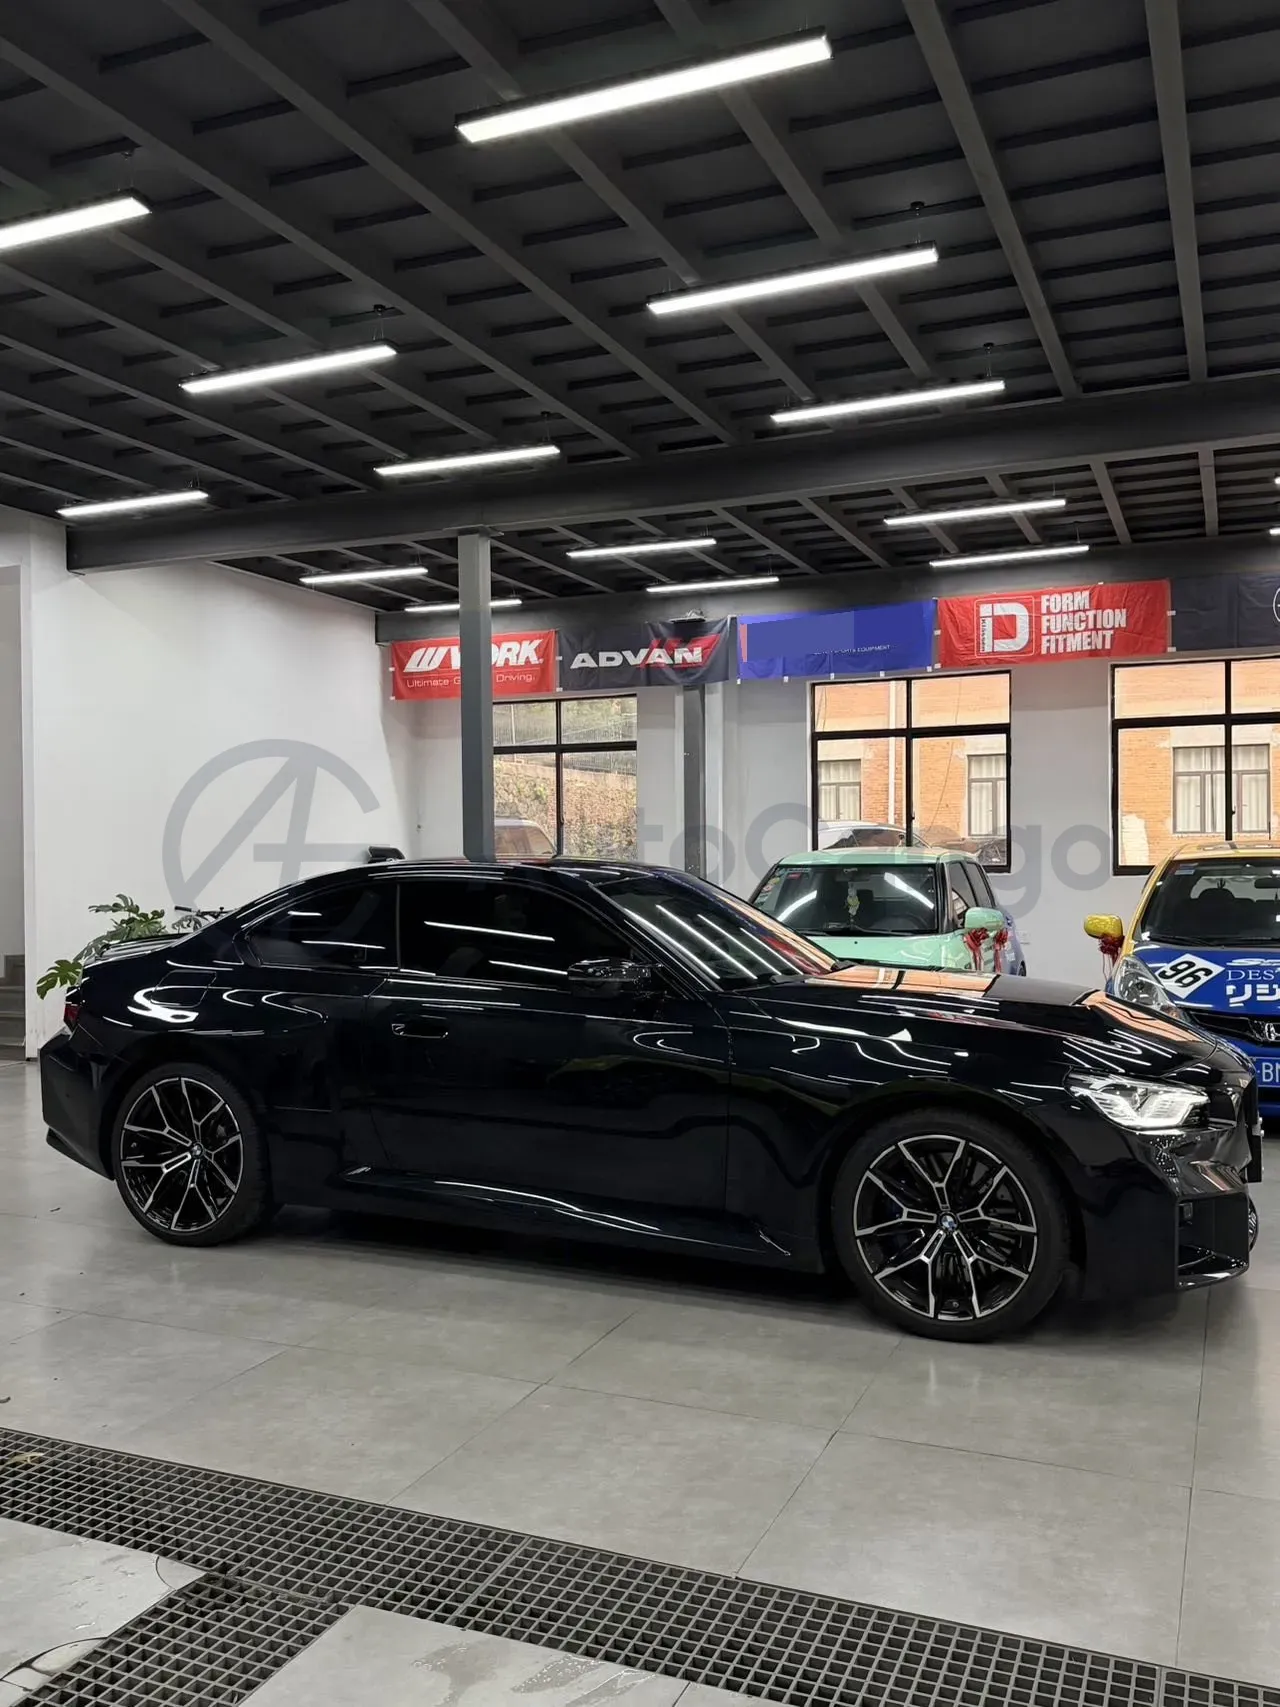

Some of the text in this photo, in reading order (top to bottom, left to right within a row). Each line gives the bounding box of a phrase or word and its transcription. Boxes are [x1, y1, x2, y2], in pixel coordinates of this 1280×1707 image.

[1041, 590, 1090, 613] FORM
[1041, 608, 1127, 634] FUNCTION
[1041, 630, 1114, 654] FITMENT
[570, 647, 702, 669] ADVAN
[406, 678, 449, 688] Ultimate
[1158, 960, 1213, 988] 96
[1227, 968, 1280, 981] DES
